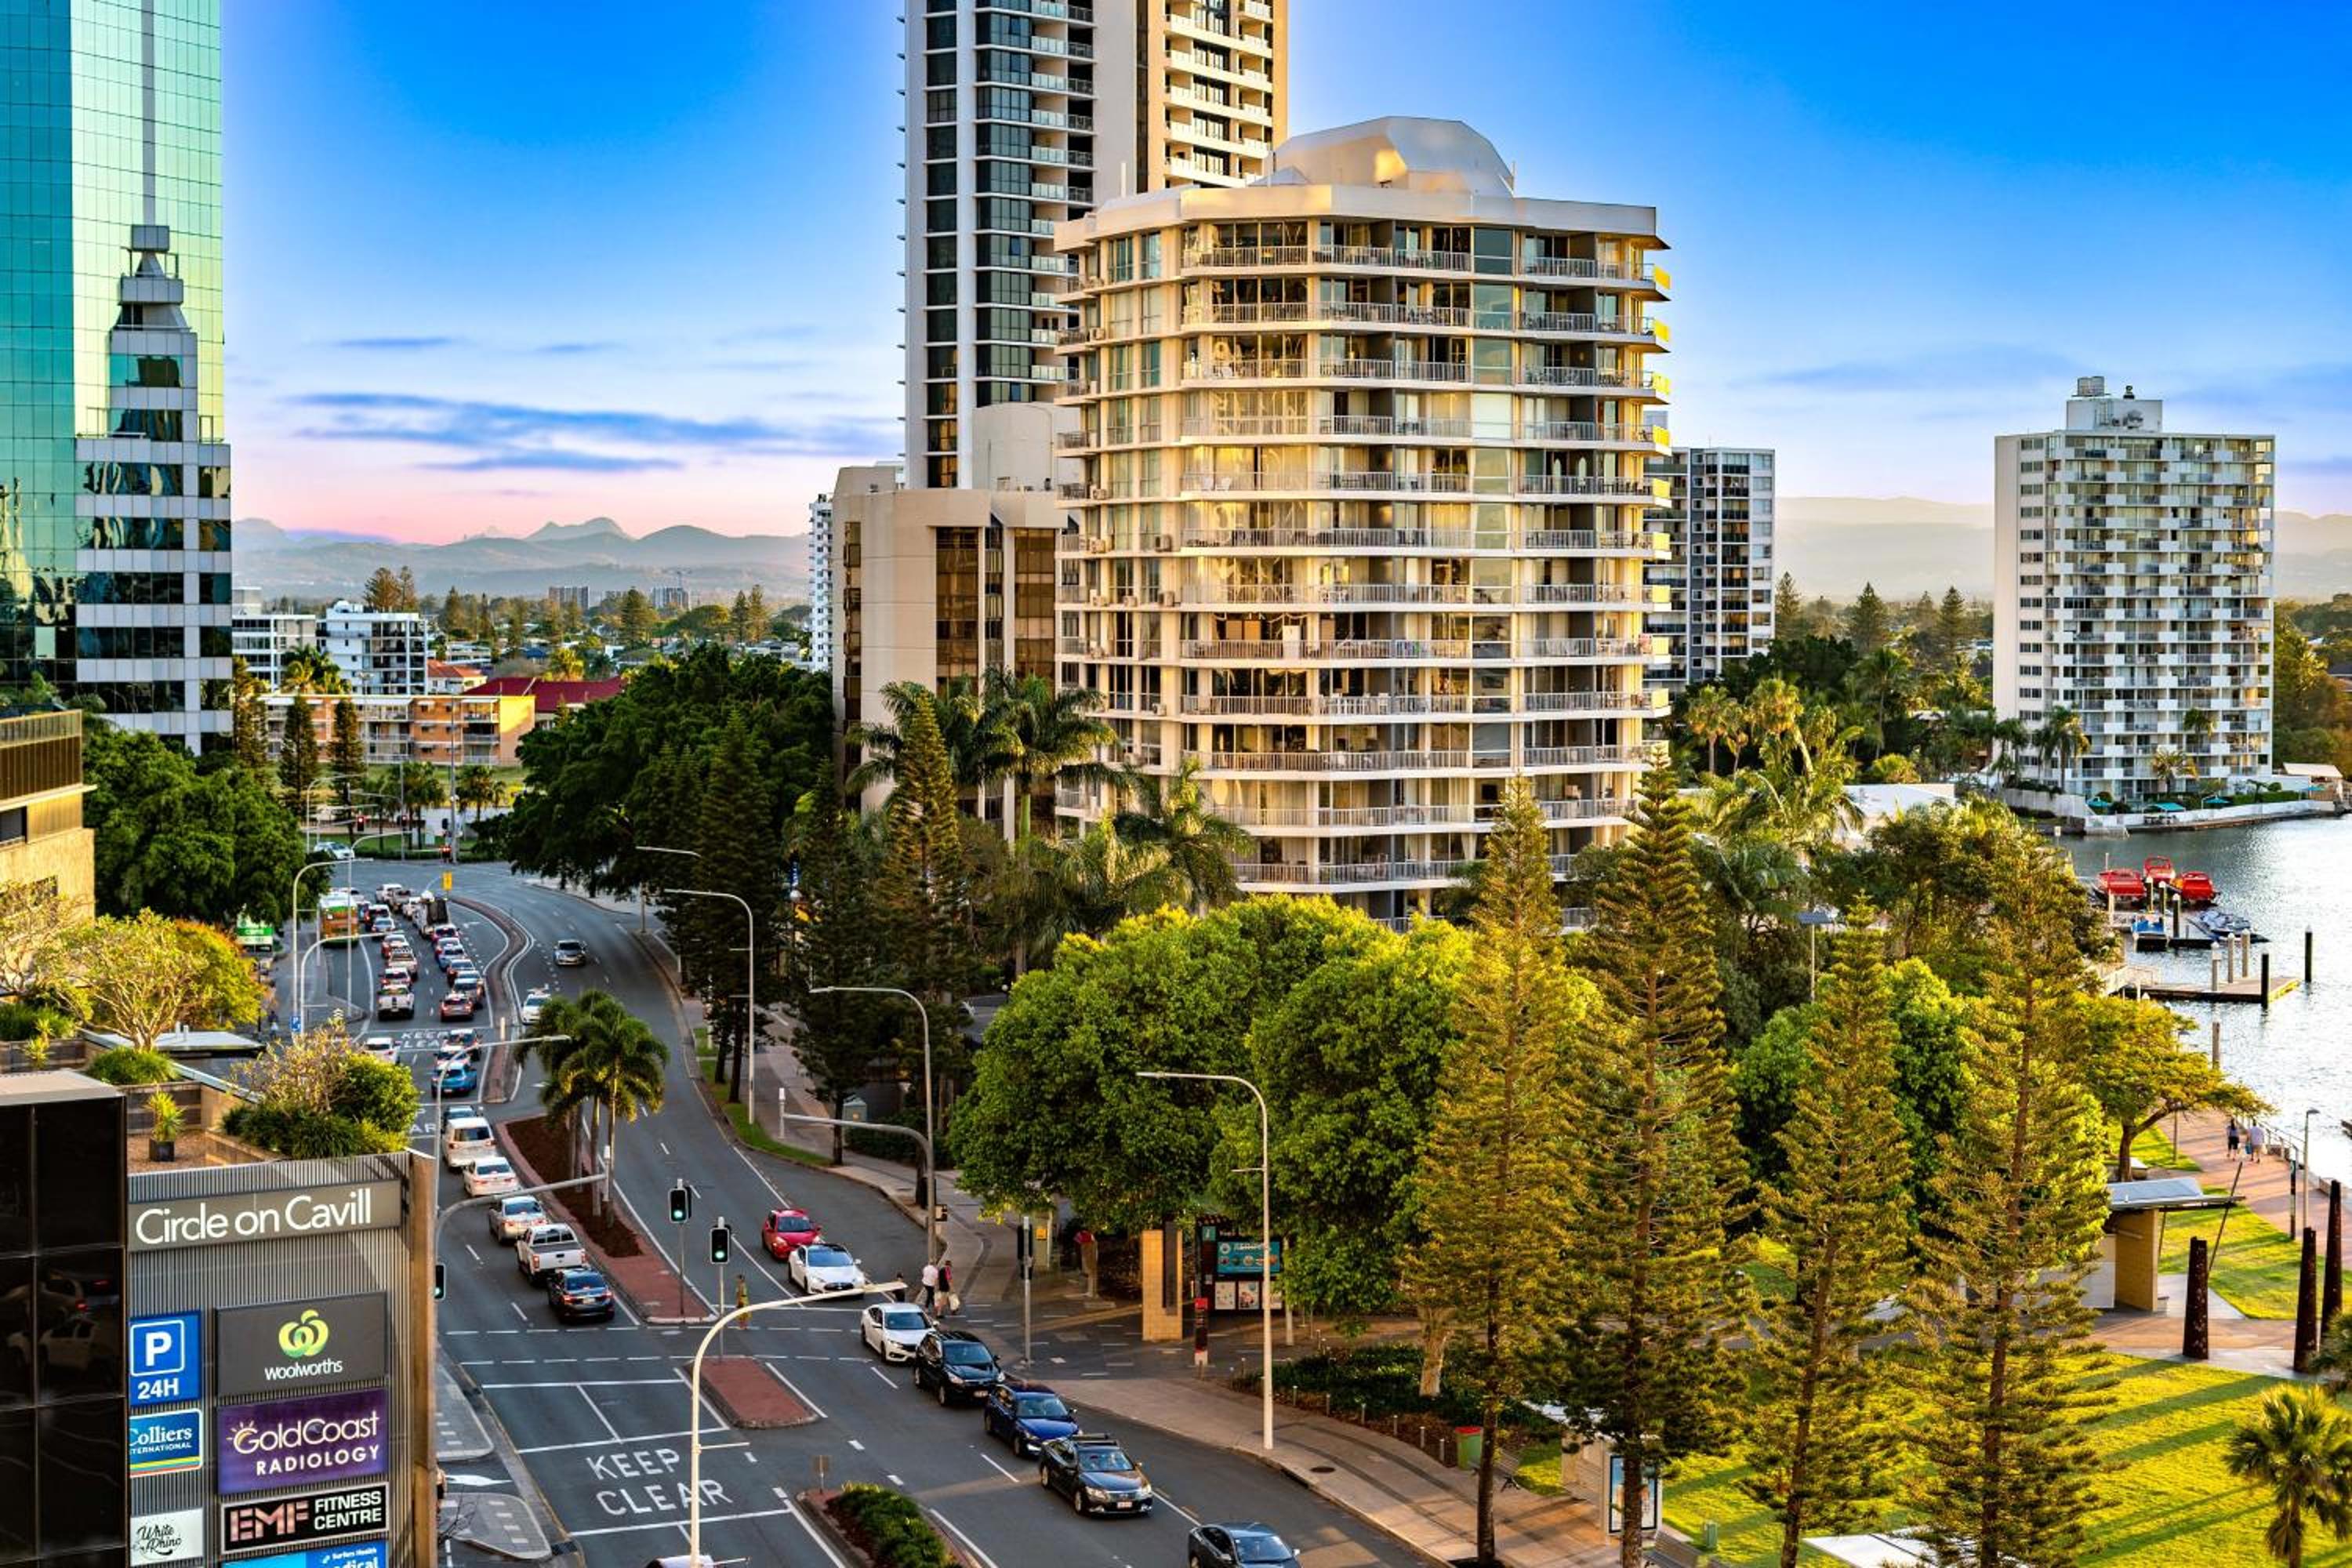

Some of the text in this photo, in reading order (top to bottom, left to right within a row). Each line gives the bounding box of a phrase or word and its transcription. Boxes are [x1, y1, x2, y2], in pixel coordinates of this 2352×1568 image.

[136, 1188, 372, 1245] Circle on Cavill
[145, 1331, 172, 1367] P
[264, 1358, 343, 1381] woolworths
[137, 1377, 179, 1399] 24H
[129, 1442, 193, 1455] TERNATIONAL
[256, 1444, 380, 1475] RADIOLOGY
[585, 1448, 681, 1481] KEEP
[314, 1490, 382, 1513] FITNESS
[596, 1479, 734, 1516] CLEAR
[136, 1524, 175, 1541] White
[230, 1501, 309, 1542] EMF
[314, 1508, 382, 1530] CENTRE
